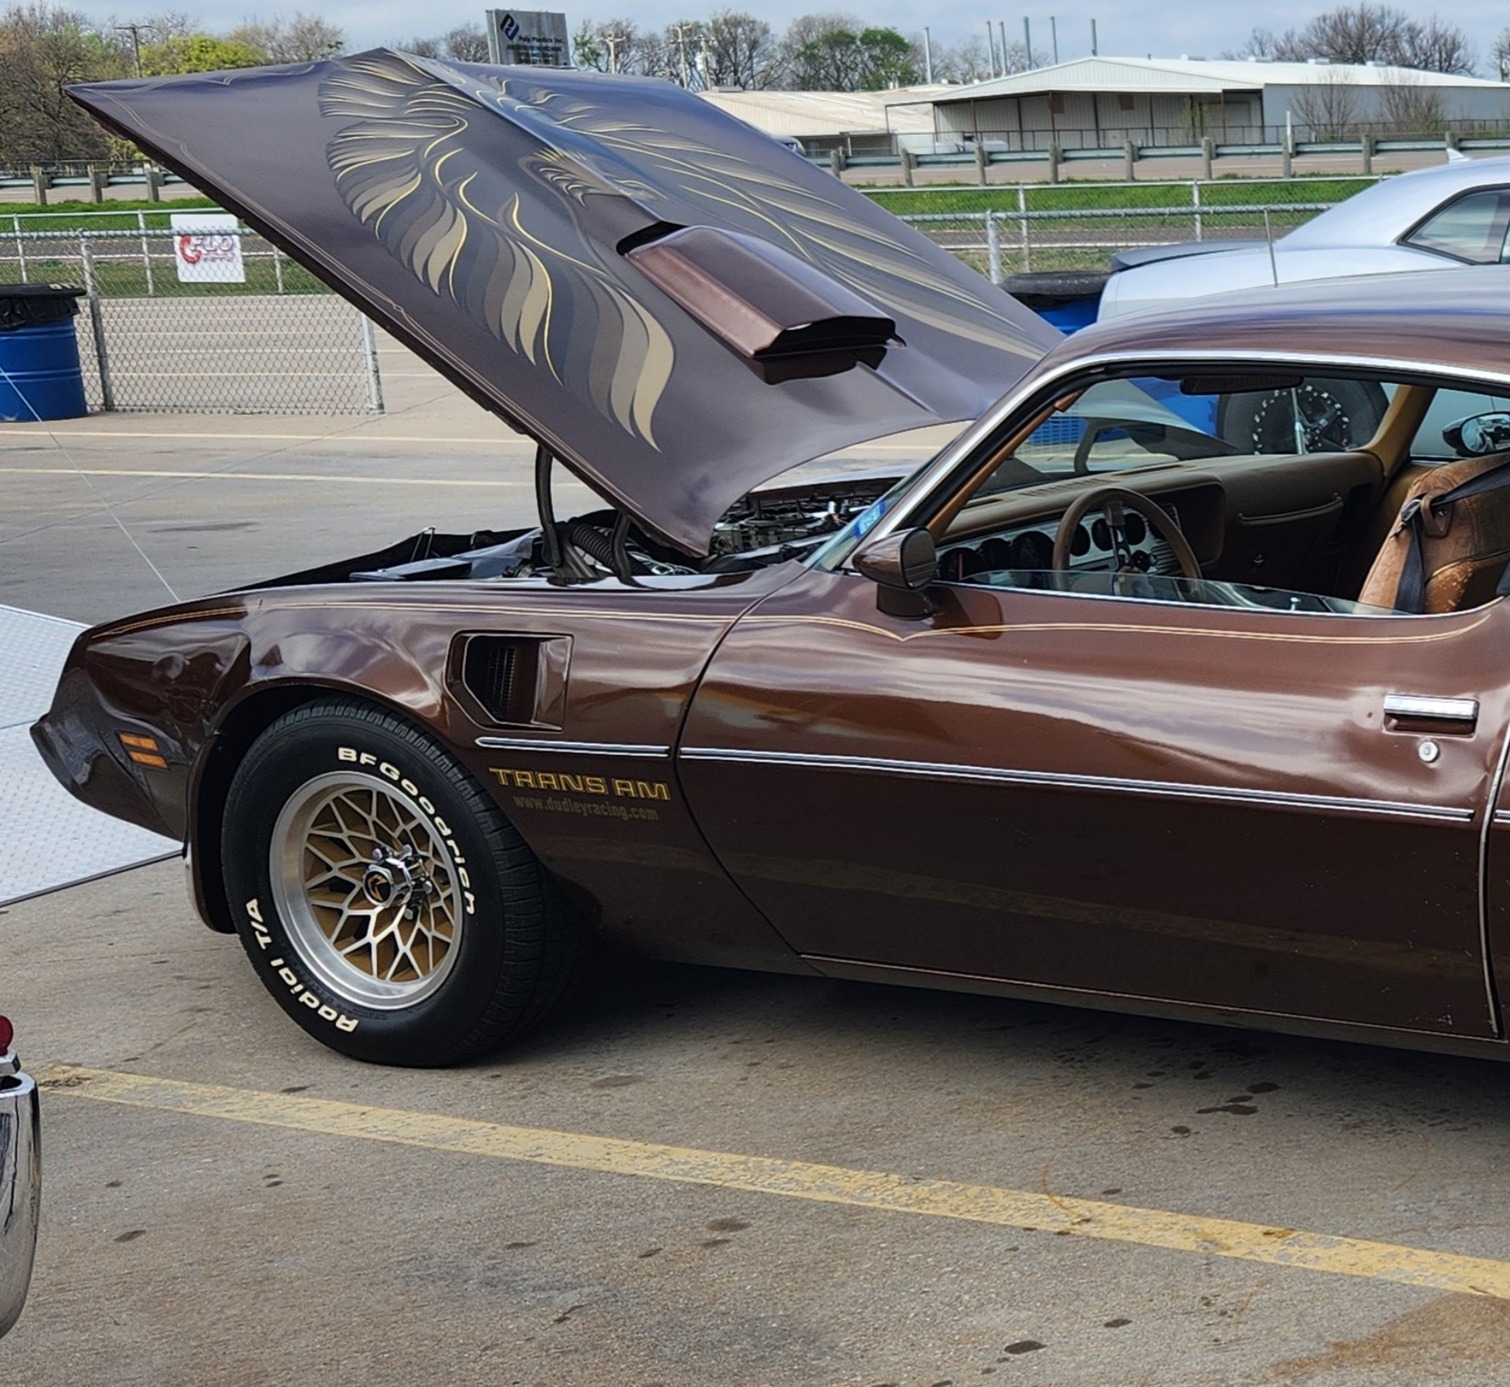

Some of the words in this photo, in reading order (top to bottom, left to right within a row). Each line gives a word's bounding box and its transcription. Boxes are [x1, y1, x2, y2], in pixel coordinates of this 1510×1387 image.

[488, 767, 609, 796] TRANS
[611, 778, 671, 801] AM
[512, 795, 660, 821] www.dudleyracing.com
[338, 746, 477, 916] BFGoodrich
[245, 898, 273, 951] T/A
[270, 958, 360, 1034] Radial
